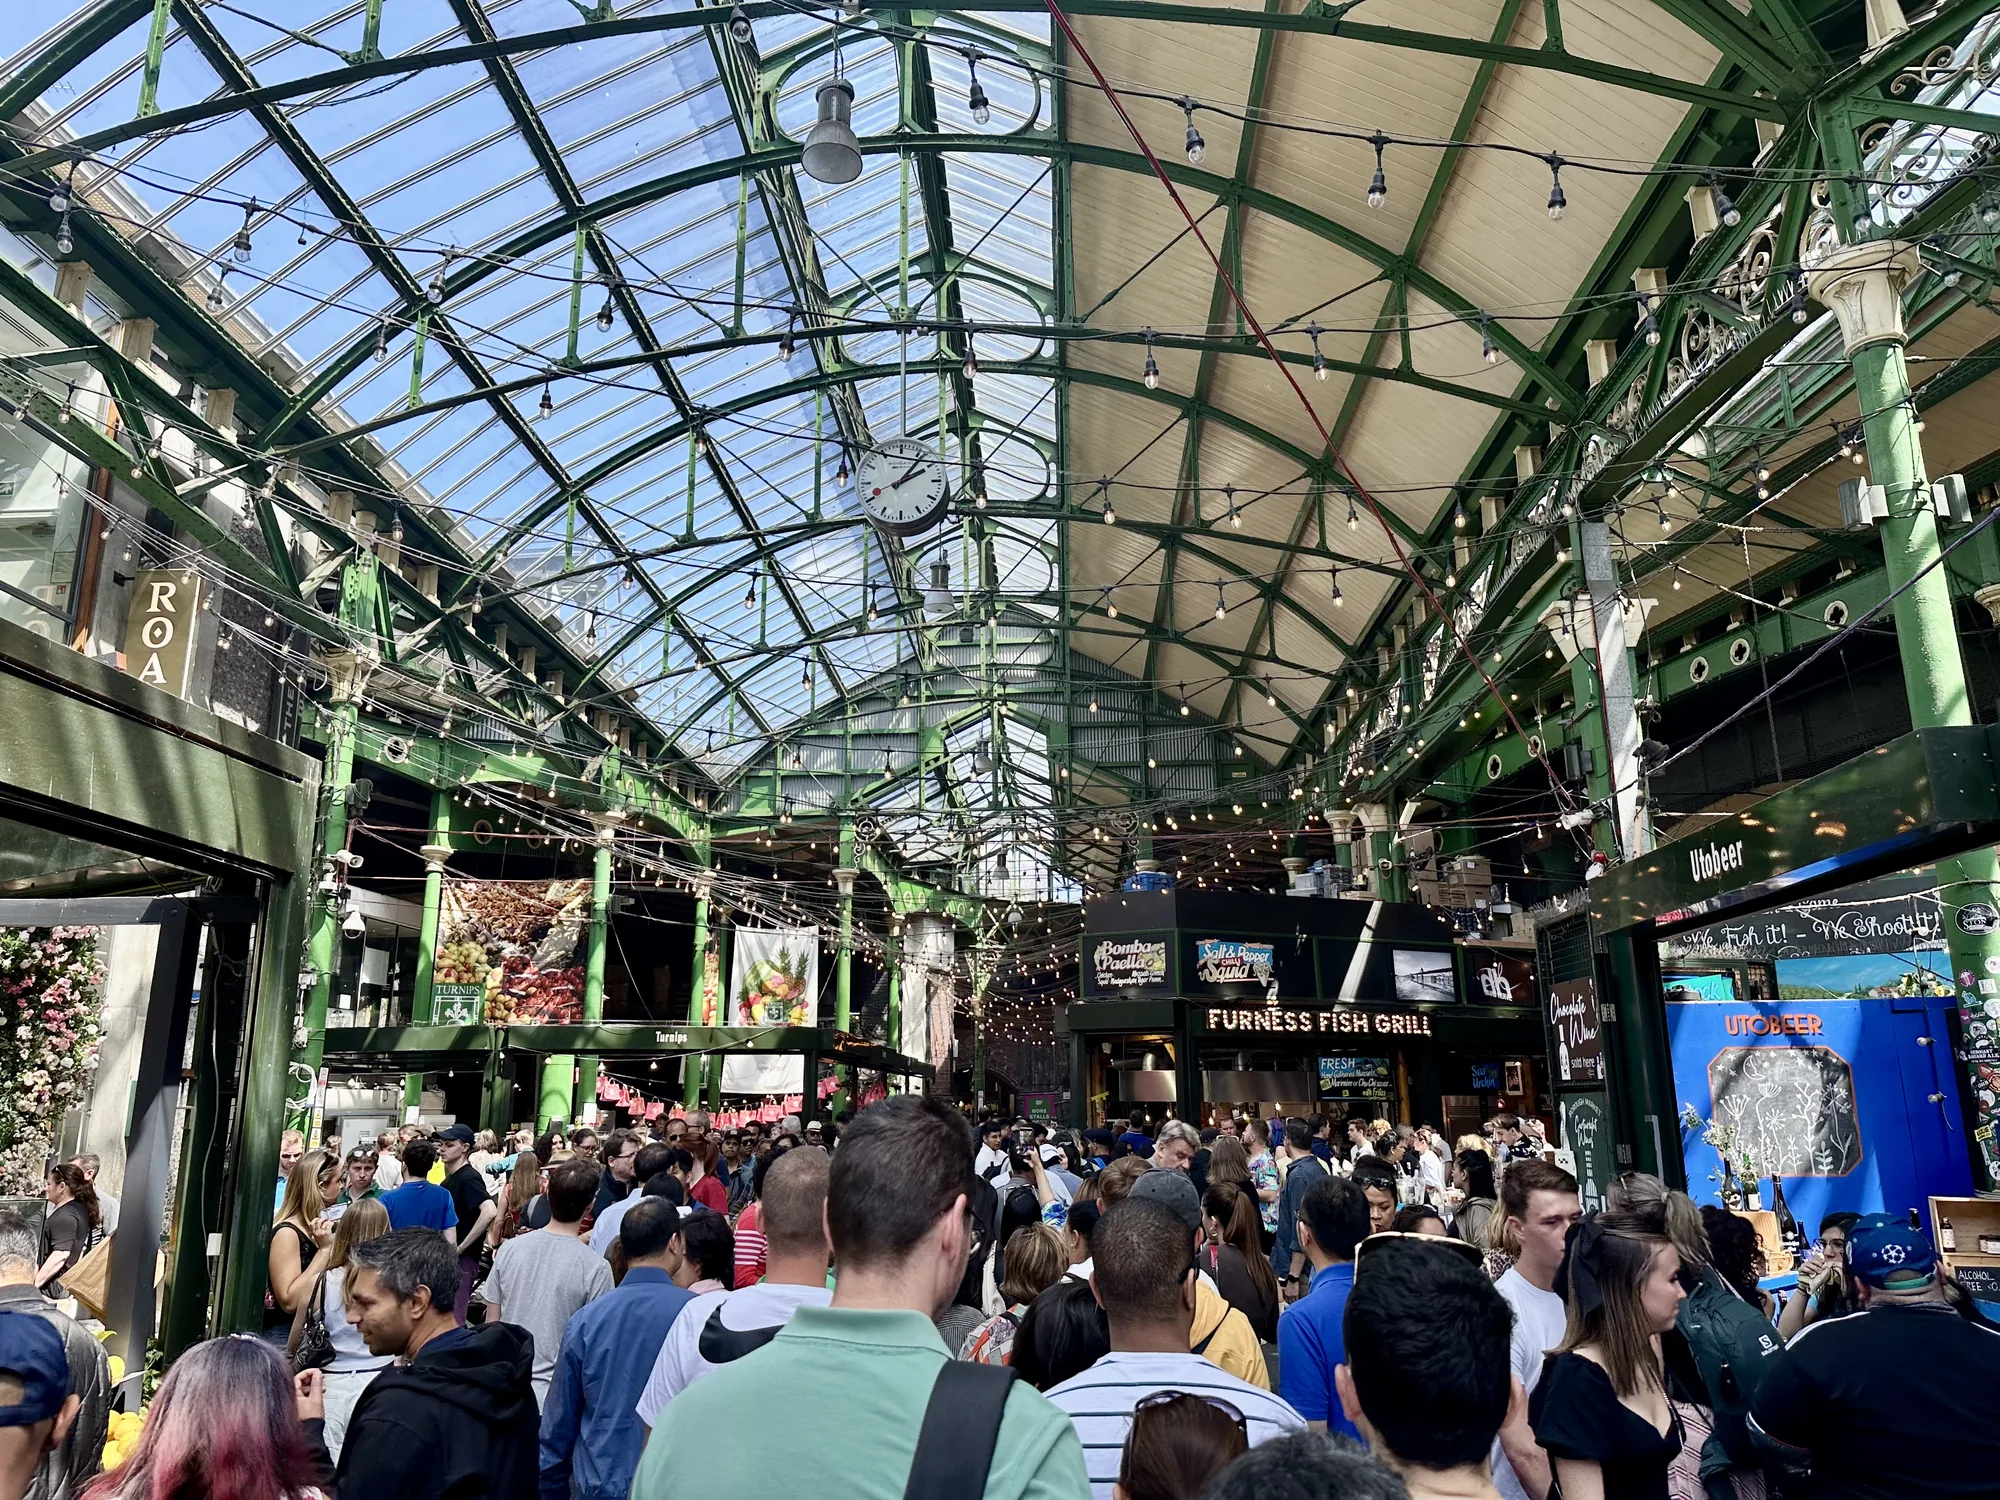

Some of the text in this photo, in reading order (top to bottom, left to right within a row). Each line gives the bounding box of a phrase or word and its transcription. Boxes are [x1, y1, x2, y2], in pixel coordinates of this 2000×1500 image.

[1690, 840, 1742, 882] Utobeer
[1720, 924, 1758, 950] Fish
[1765, 924, 1788, 945] it!
[1102, 940, 1152, 956] Bomba
[1203, 944, 1270, 962] Salt & Pepper
[1101, 954, 1145, 970] Paella
[1198, 958, 1250, 984] Squid
[436, 985, 480, 994] TURNIPS
[1550, 992, 1586, 1025] Chocolate
[1208, 1008, 1432, 1037] FURNESS FISH GRILL
[1569, 1013, 1598, 1048] Wine
[1724, 1014, 1824, 1036] UTOBEER
[655, 1031, 688, 1043] Turnips
[1322, 1058, 1356, 1070] FRESH
[1571, 1055, 1594, 1068] sold here
[1472, 1065, 1486, 1077] Sea
[1472, 1078, 1496, 1089] Urchin
[1568, 1098, 1602, 1118] BOROUGH MARKET
[1958, 1270, 1995, 1280] ALCOHOL
